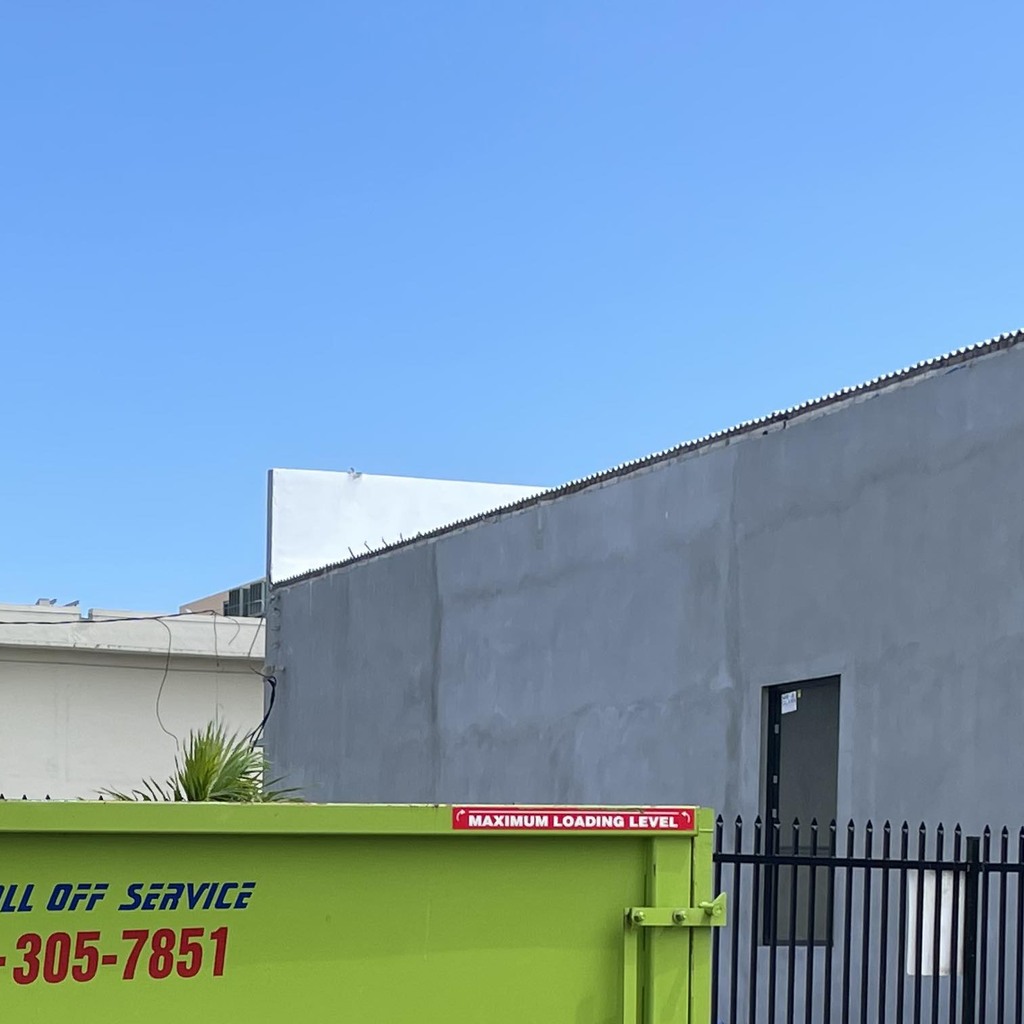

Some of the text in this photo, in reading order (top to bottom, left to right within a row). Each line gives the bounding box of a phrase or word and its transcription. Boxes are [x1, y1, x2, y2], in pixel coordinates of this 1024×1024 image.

[468, 814, 678, 829] MAXIMUM LOADING LEVEL
[46, 883, 109, 911] OFF
[118, 882, 256, 911] SERVICE
